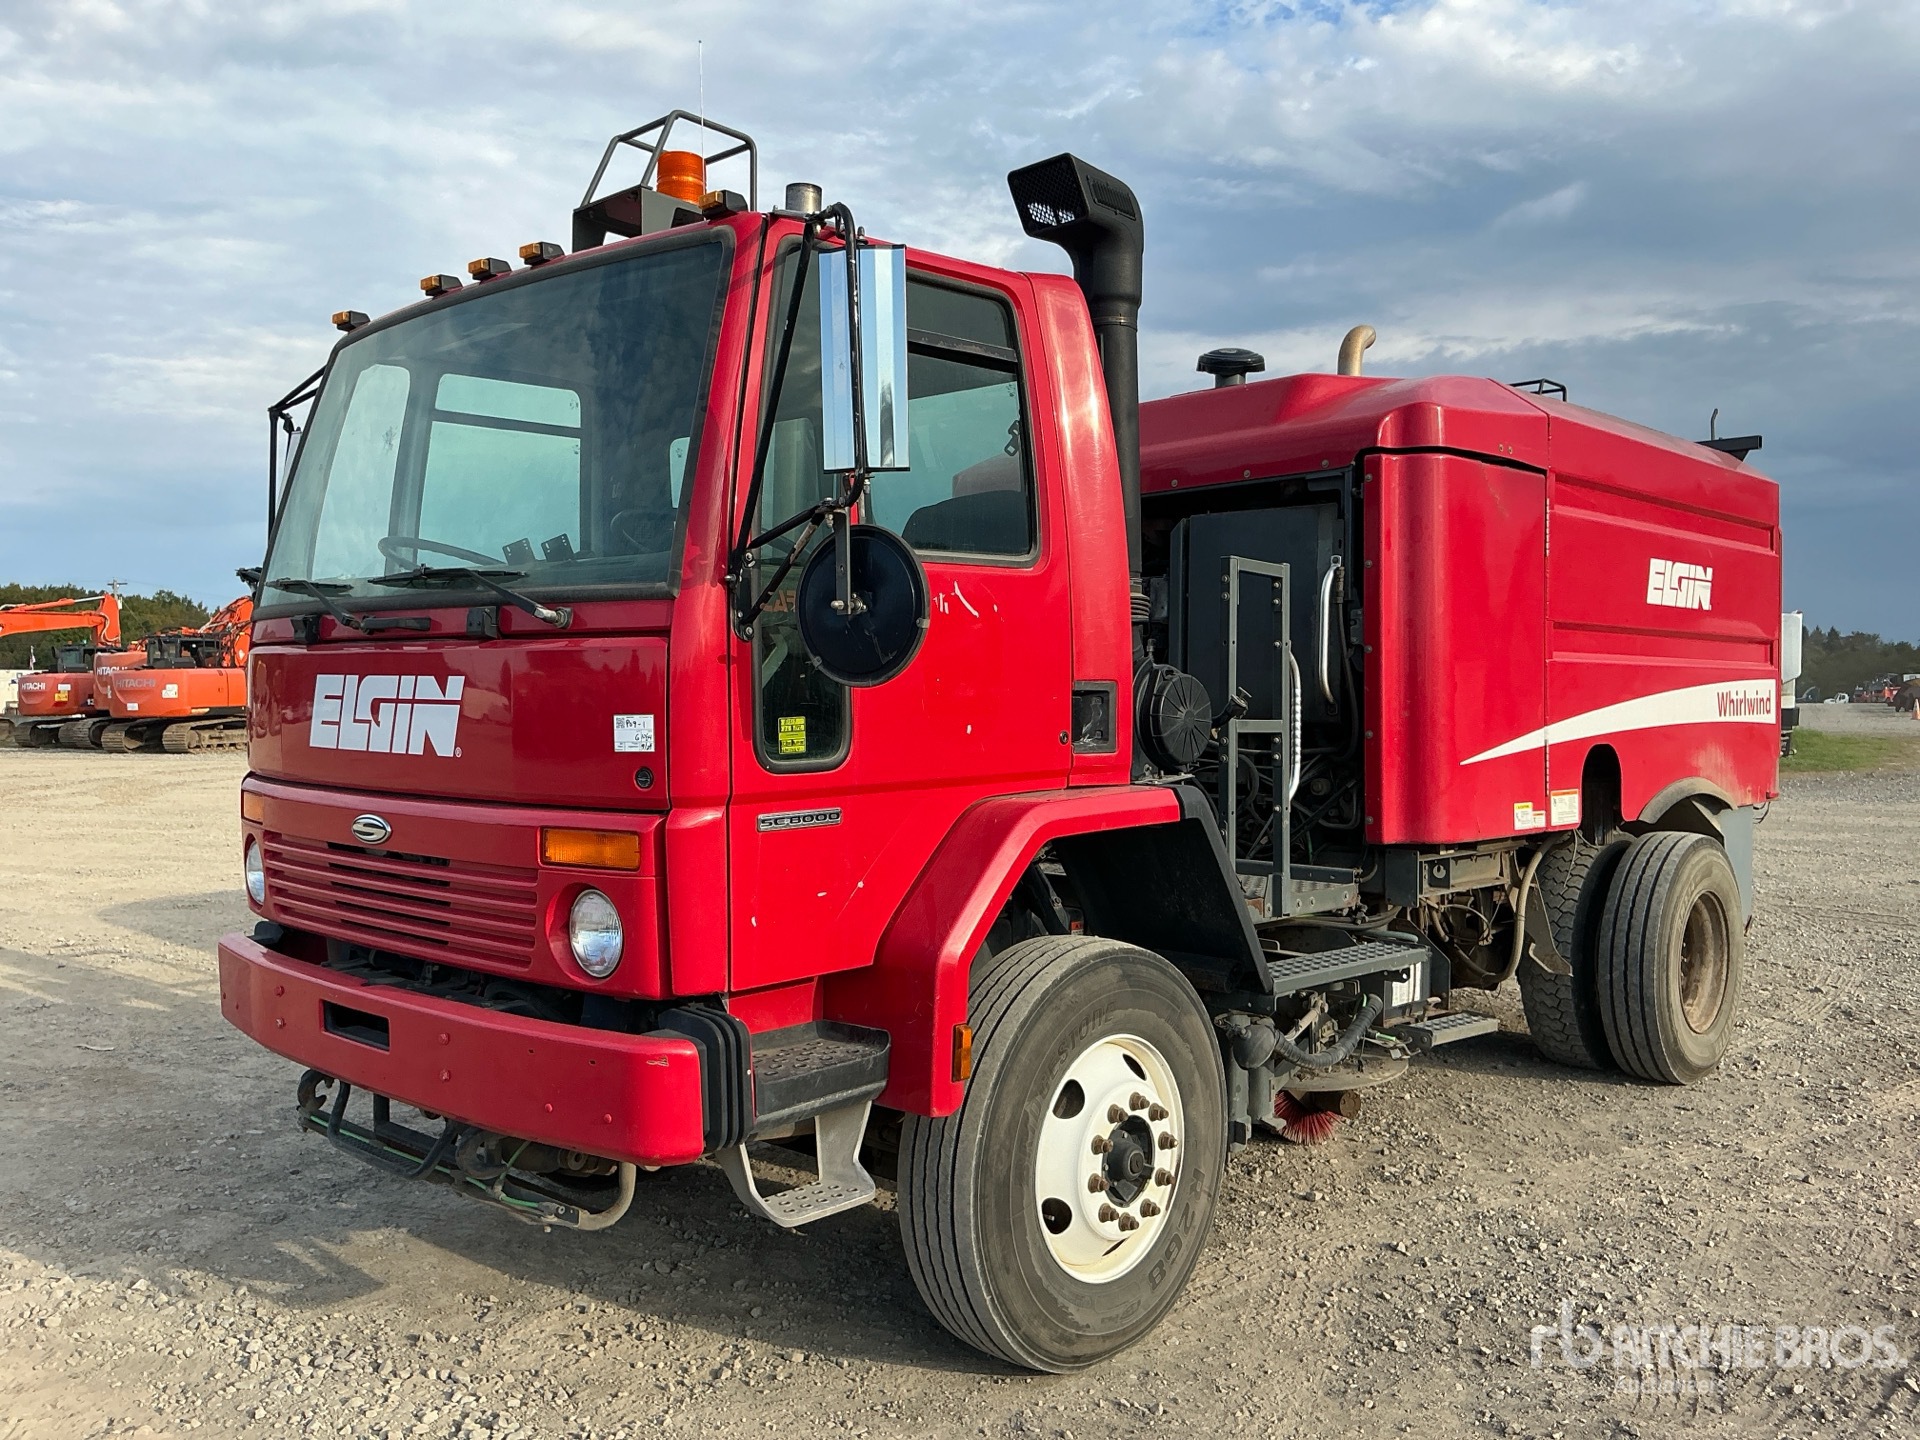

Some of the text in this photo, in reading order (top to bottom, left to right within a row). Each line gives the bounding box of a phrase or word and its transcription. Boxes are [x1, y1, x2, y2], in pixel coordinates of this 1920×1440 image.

[1647, 558, 1713, 610] ELGIN
[97, 667, 128, 675] HITAC
[21, 682, 46, 690] HITACHI
[115, 679, 156, 688] HITACHI
[1717, 690, 1771, 717] Whirlwind
[310, 674, 466, 757] ELGIN
[760, 812, 841, 827] SC8000
[1023, 1001, 1114, 1165] IDGESTONE
